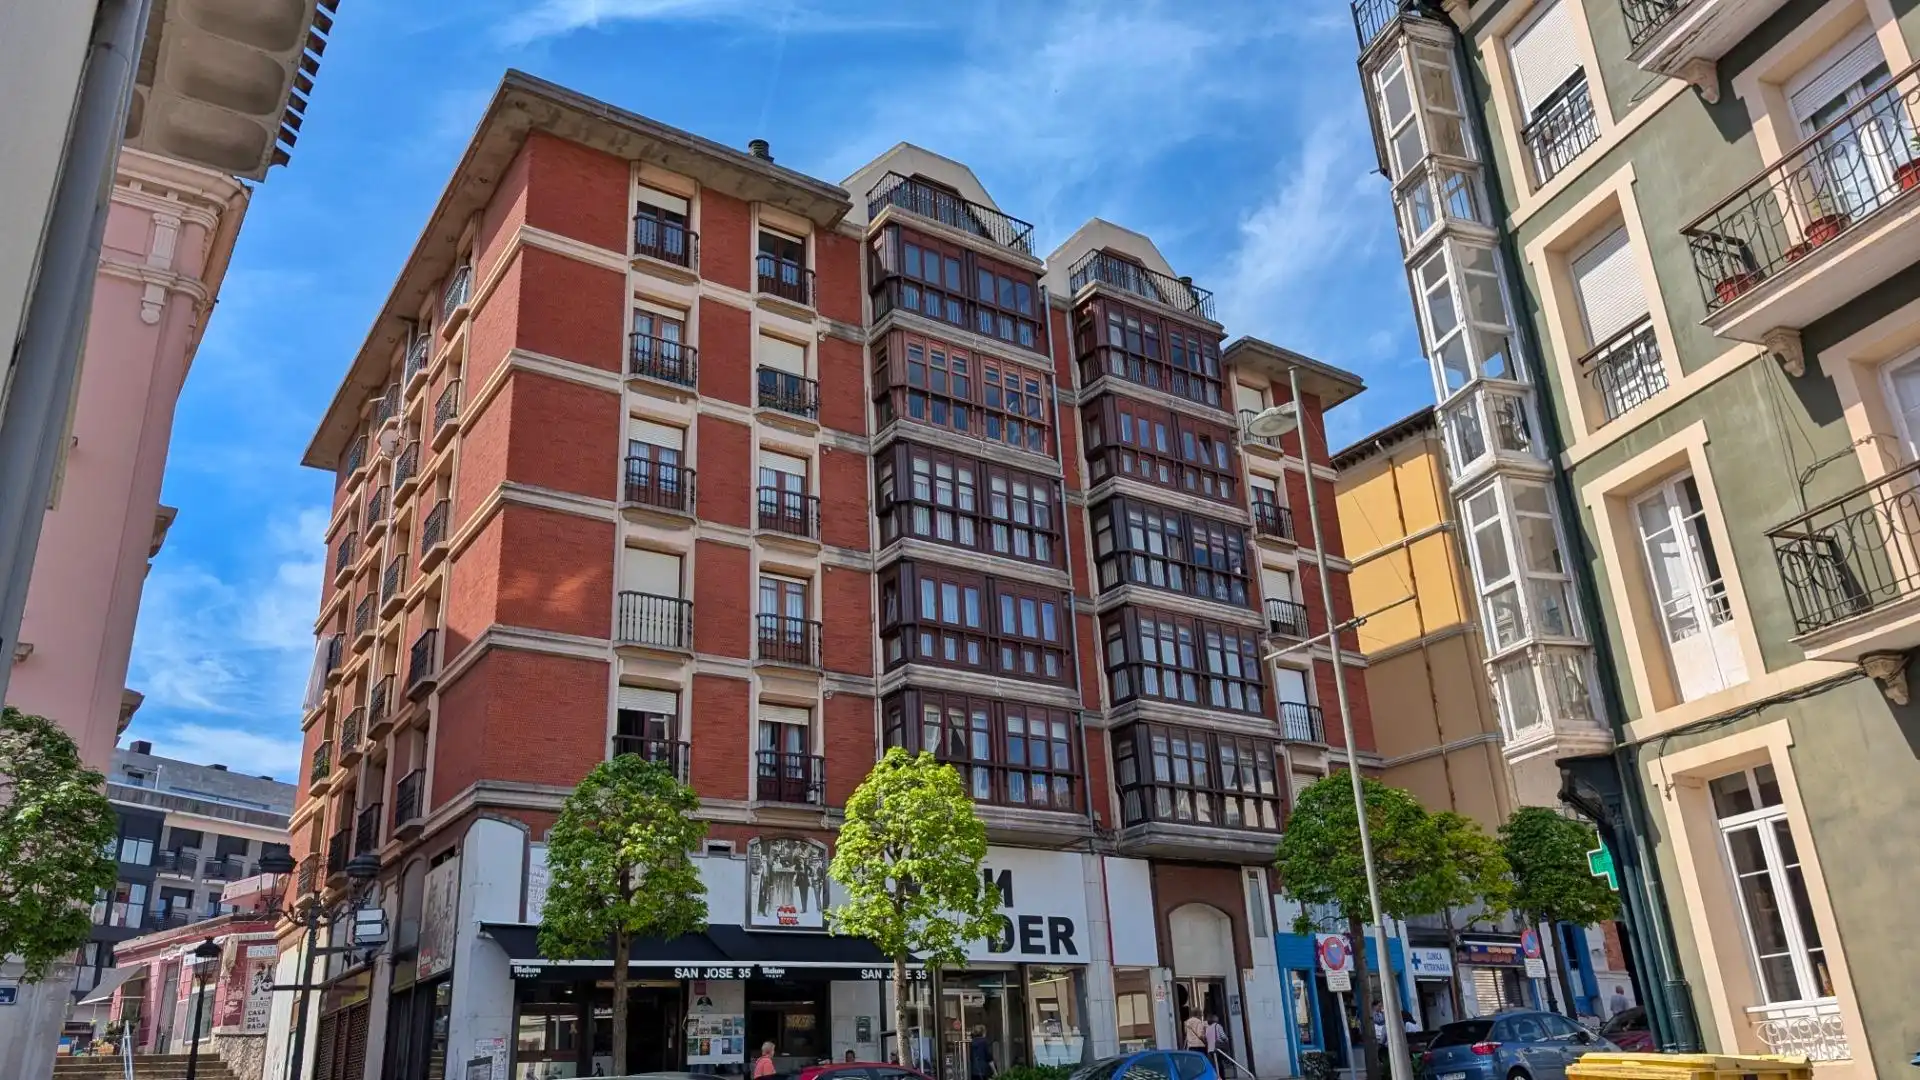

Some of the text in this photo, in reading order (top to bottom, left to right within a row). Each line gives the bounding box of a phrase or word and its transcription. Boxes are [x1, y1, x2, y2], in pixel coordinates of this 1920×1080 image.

[674, 968, 751, 978] SAN JOSE 35
[861, 969, 882, 979] SAN
[916, 970, 927, 979] 35
